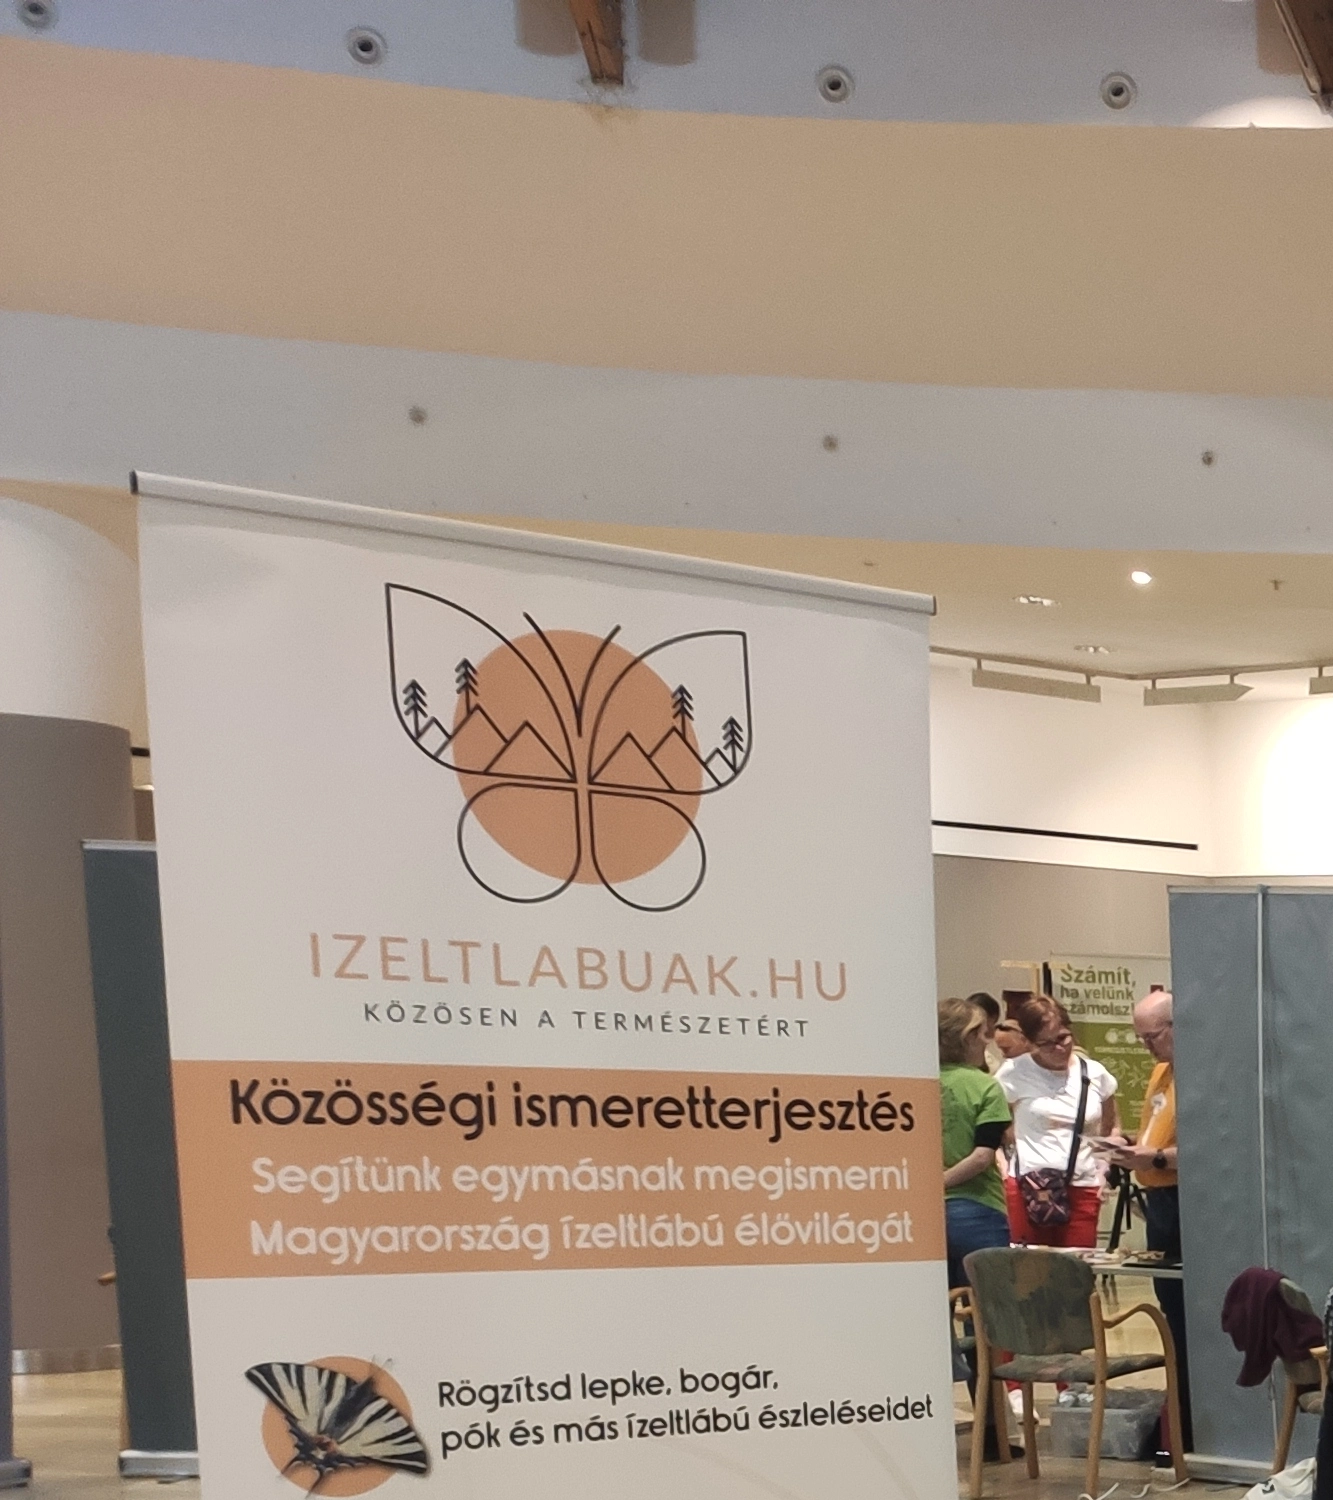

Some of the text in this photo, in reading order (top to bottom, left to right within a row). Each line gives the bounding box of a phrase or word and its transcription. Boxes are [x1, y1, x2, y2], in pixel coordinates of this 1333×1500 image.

[309, 931, 847, 1001] IZELTLABUAK.HU
[1060, 963, 1136, 987] Számít,
[1059, 985, 1135, 1001] ha velünk
[364, 1000, 809, 1037] KÖZÖSEN A TERMÉSZETÉRT
[230, 1078, 915, 1144] Közösségi ismeretterjesztés
[252, 1155, 909, 1204] Segítünk egymásnak megismerni
[251, 1216, 550, 1265] Magyarország
[560, 1212, 724, 1249] ízeltlábú
[437, 1364, 779, 1413] Rögzítsd lepke, bogár,
[441, 1394, 934, 1460] pók és más ízeltlábú észleléseidet
